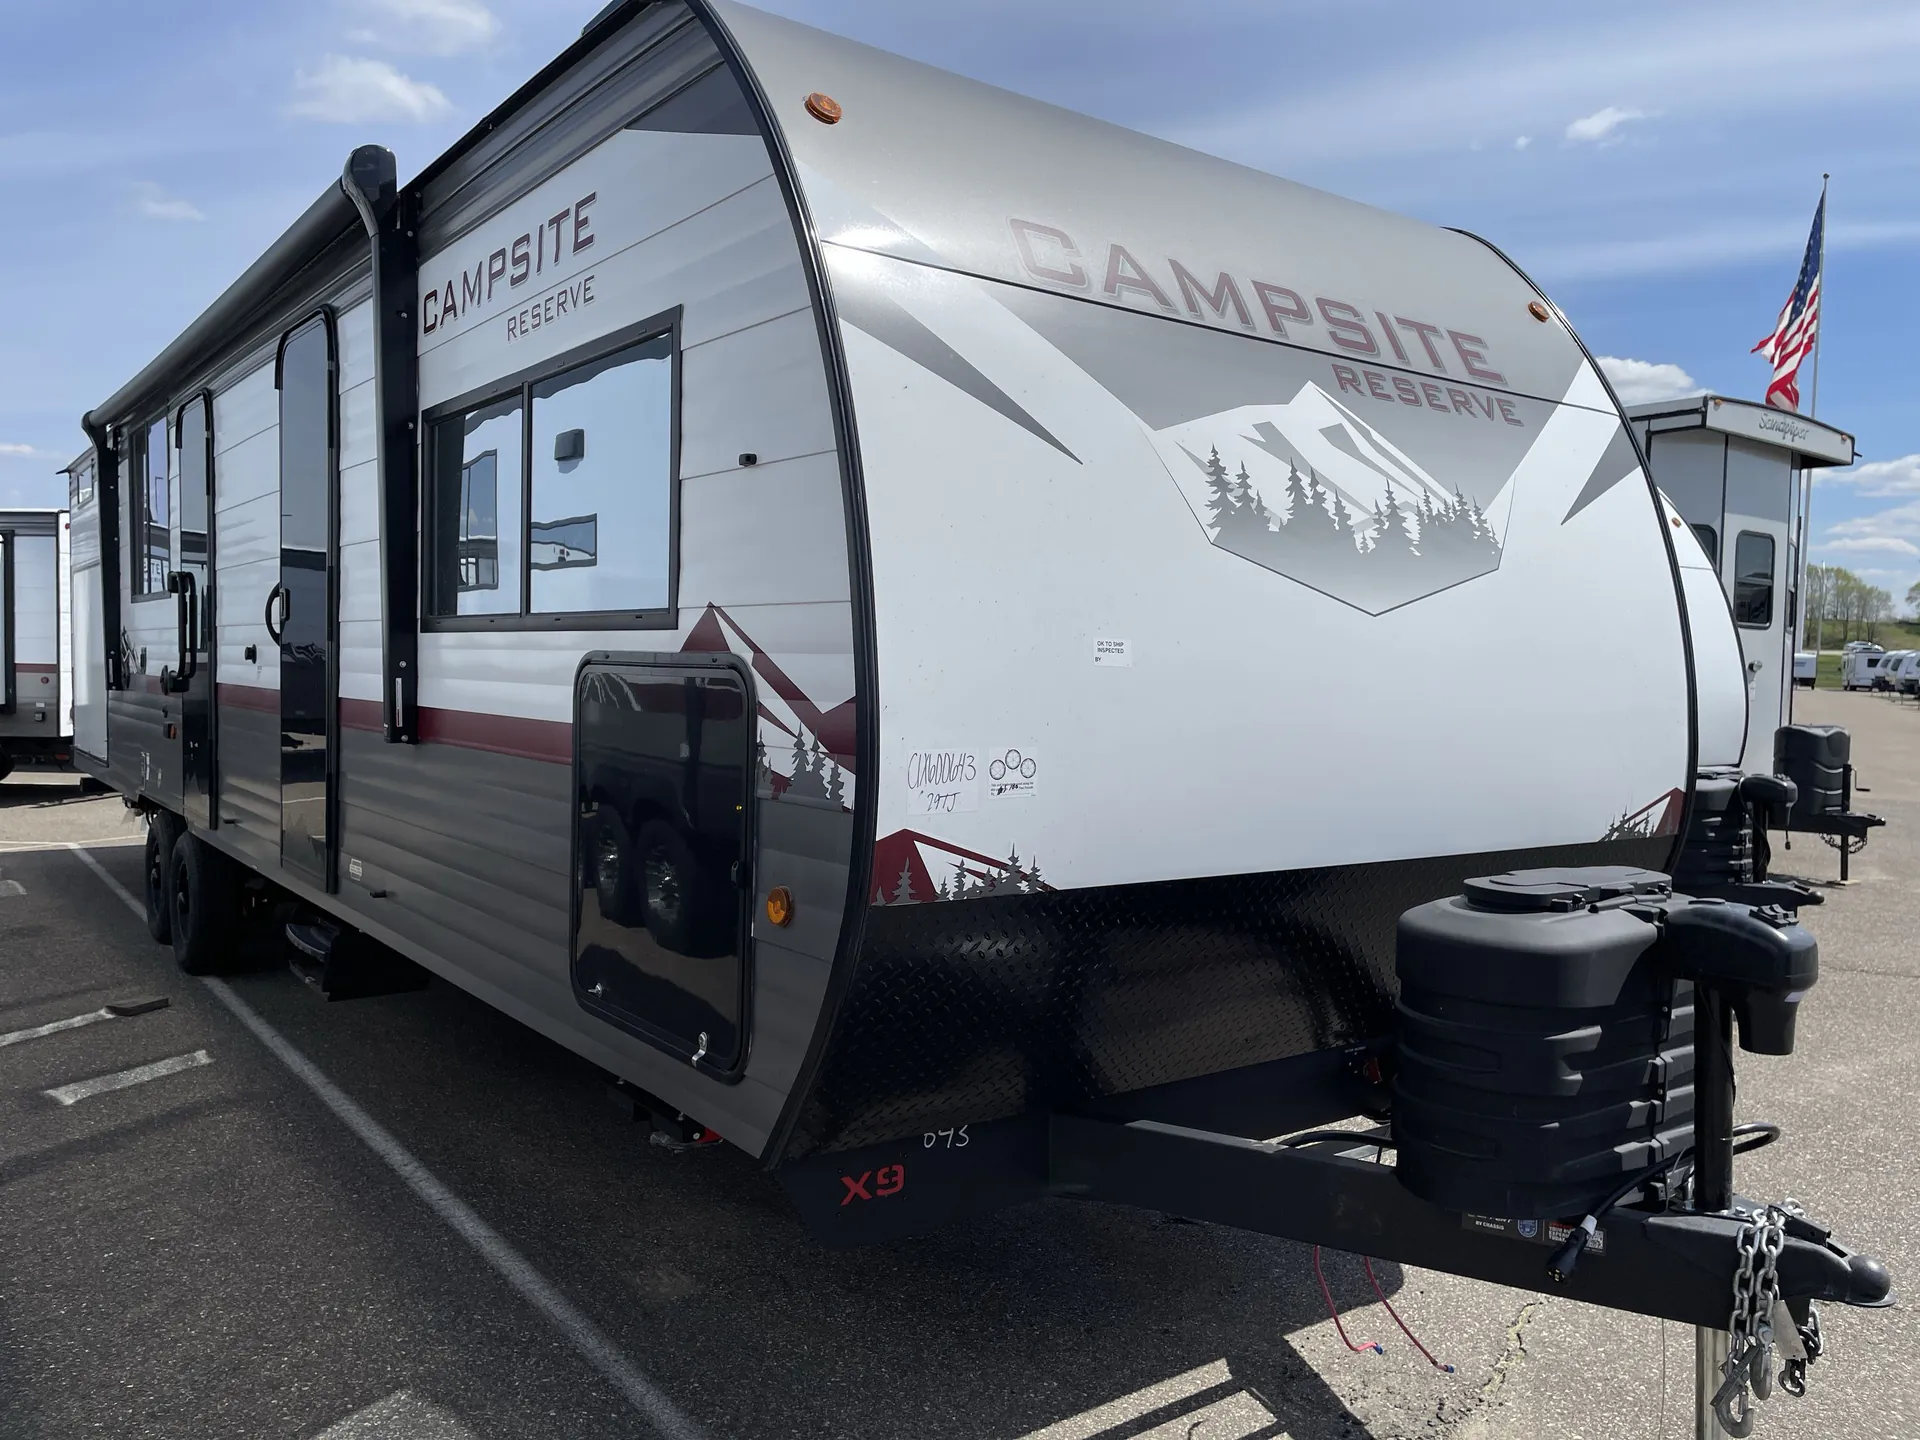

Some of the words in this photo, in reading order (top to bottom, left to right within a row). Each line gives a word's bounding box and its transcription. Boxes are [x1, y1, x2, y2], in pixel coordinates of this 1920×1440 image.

[423, 191, 597, 336] CAMPSITE
[507, 274, 596, 342] RESERVE
[1006, 216, 1508, 386] CAMPSITE
[1331, 363, 1525, 427] RESERVE
[1759, 412, 1810, 442] Sandpiper
[840, 1164, 905, 1206] X9
[1483, 1221, 1505, 1230] CHASSIS
